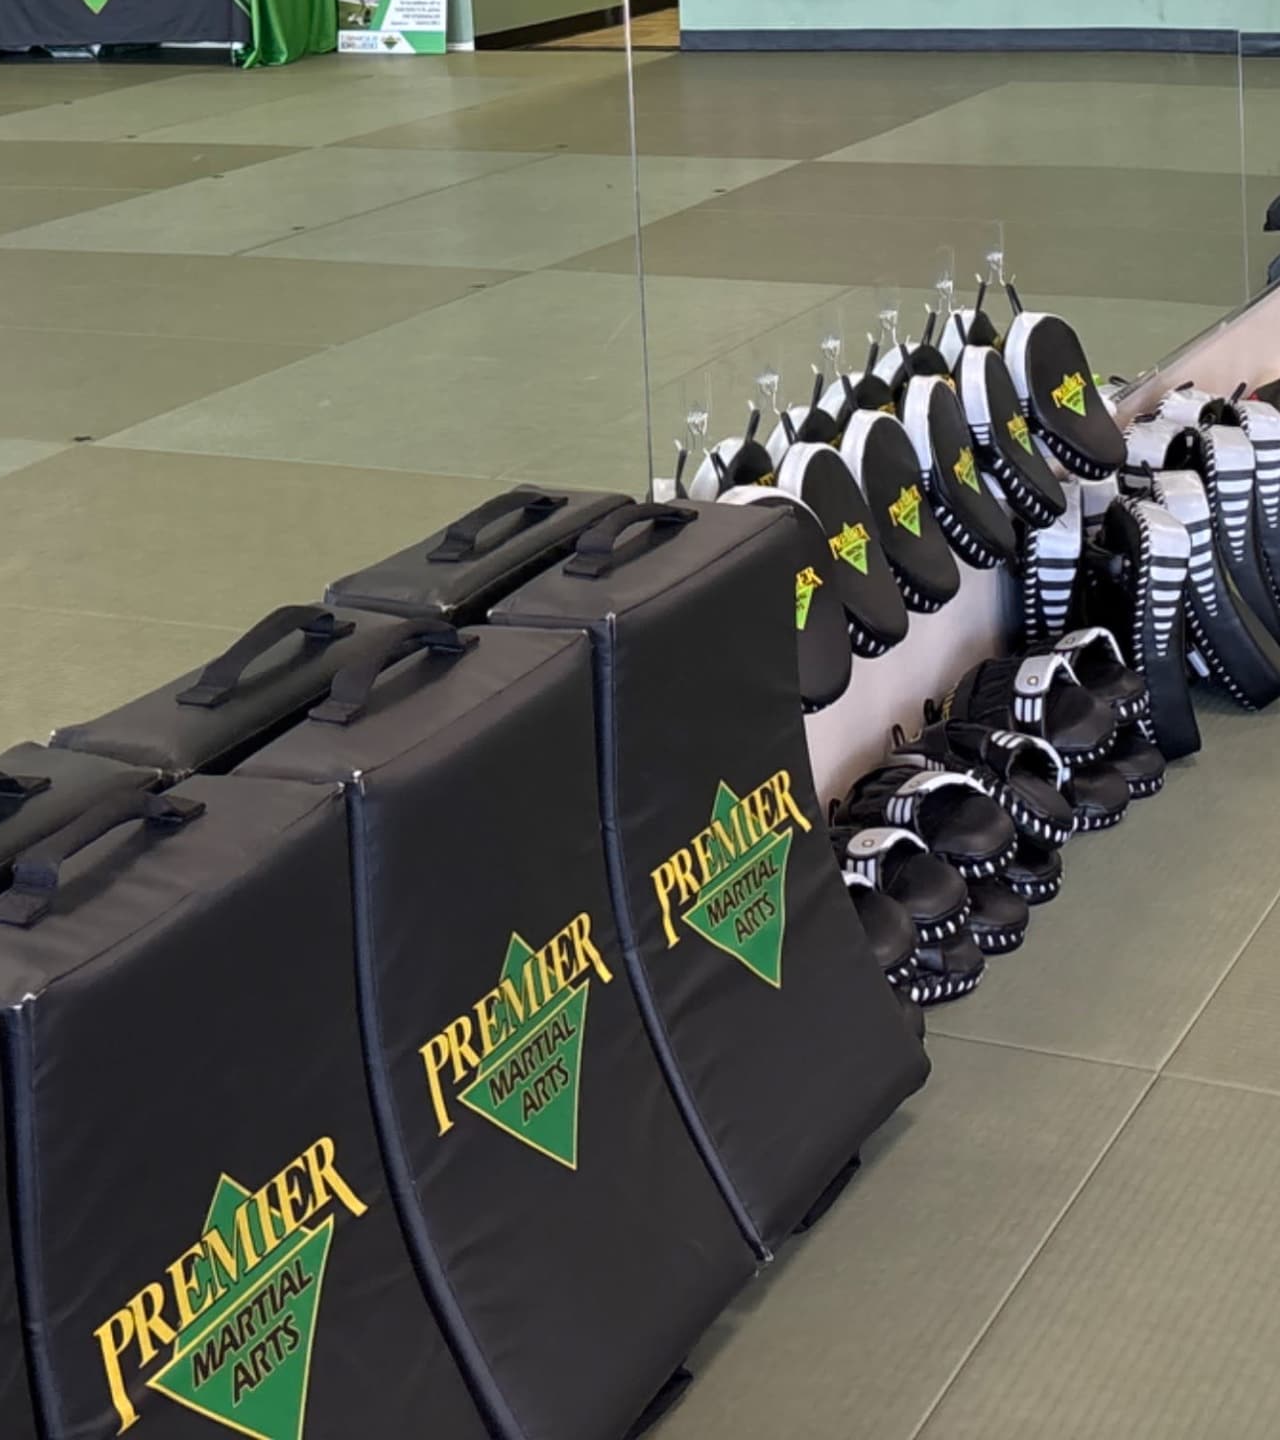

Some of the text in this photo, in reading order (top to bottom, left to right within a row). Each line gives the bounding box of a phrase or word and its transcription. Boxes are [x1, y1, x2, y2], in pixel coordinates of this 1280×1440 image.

[650, 769, 812, 949] PREMIER
[706, 854, 778, 926] MARTIAL
[734, 892, 774, 945] ARTS
[418, 911, 613, 1137] PREMIER
[488, 1012, 576, 1108] MARTIAL
[522, 1058, 569, 1125] ARTS
[93, 1136, 368, 1436] PREMIER
[191, 1257, 313, 1390] MARTIAL
[233, 1315, 300, 1407] ARTS
